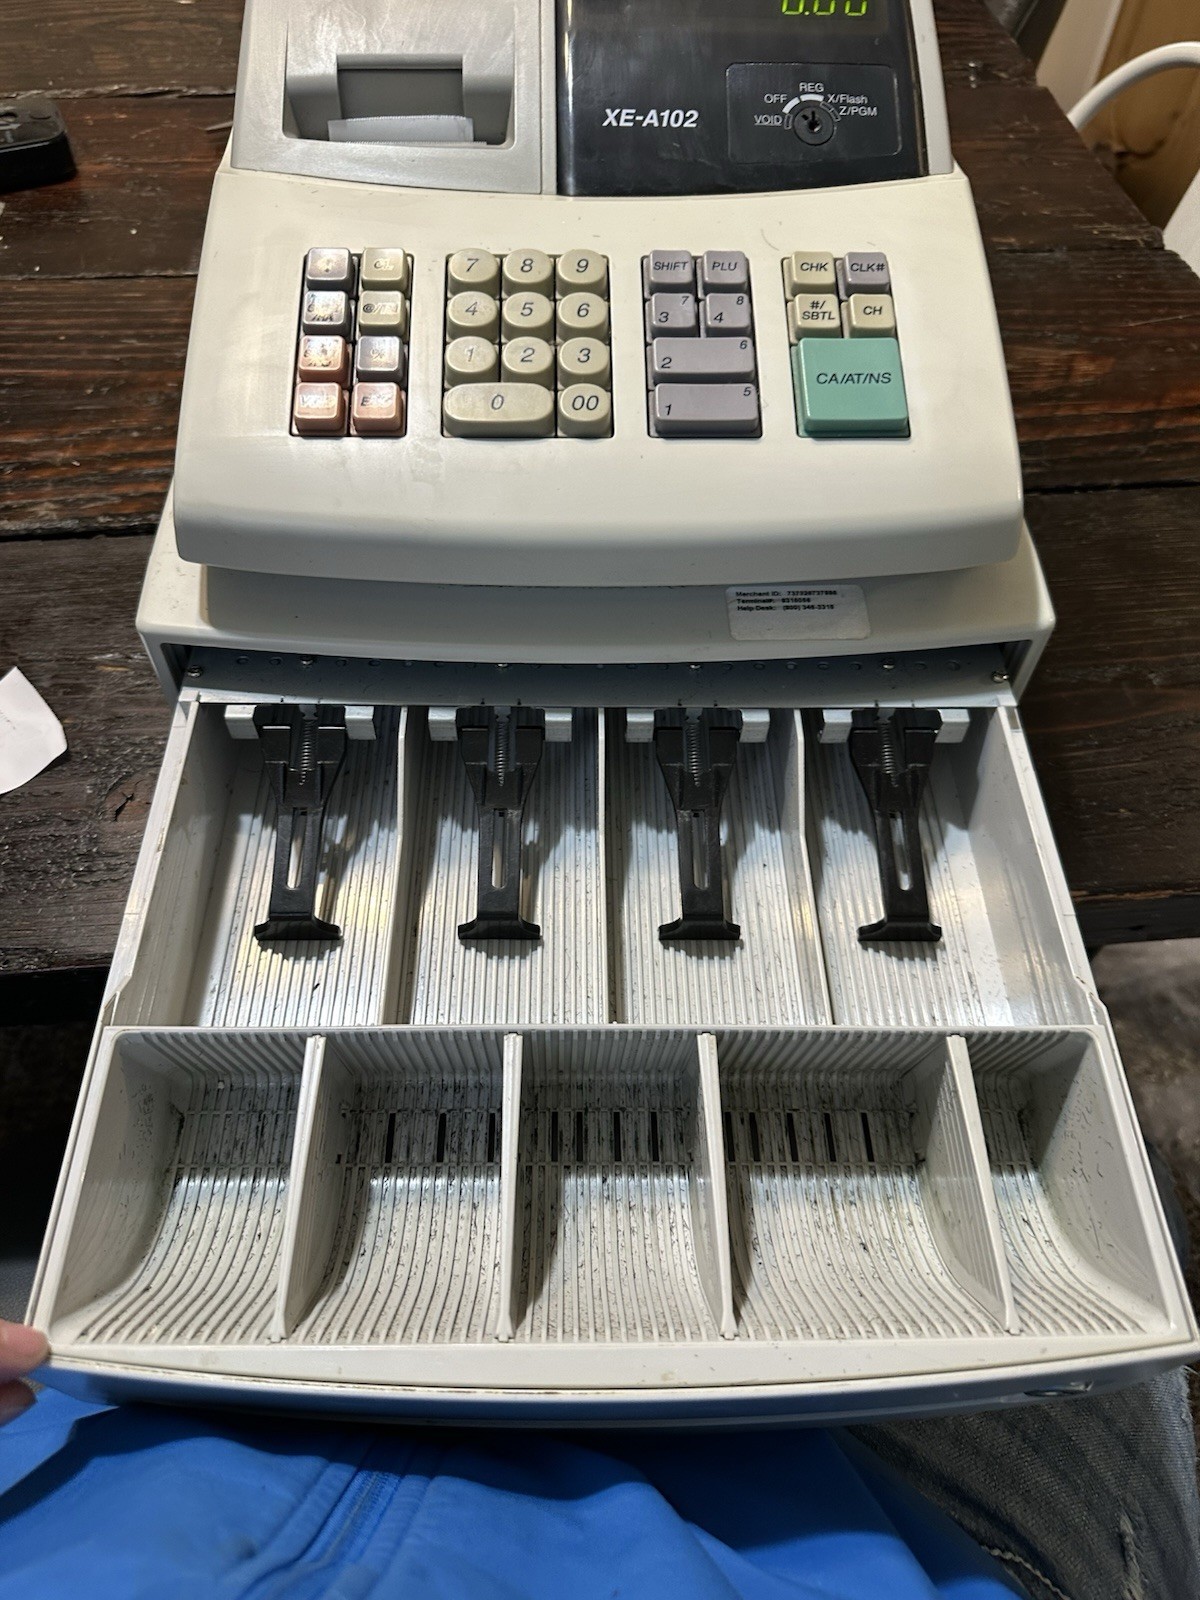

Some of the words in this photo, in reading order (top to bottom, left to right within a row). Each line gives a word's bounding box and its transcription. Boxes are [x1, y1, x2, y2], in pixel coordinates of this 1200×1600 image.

[799, 82, 824, 92] REG
[764, 93, 788, 104] OFF
[827, 93, 868, 105] X/Flash
[839, 105, 878, 117] Z/PGM
[602, 108, 699, 128] XE-A102
[754, 115, 783, 126] VOID
[465, 258, 479, 273] 7
[520, 258, 534, 273] 8
[576, 258, 589, 273] 9
[653, 261, 689, 271] SHIFT
[711, 261, 738, 271] PLU
[799, 262, 829, 271] CHK
[850, 262, 886, 272] CLK#
[681, 295, 689, 305] 7
[736, 295, 745, 305] 8
[809, 300, 826, 310] #/
[465, 301, 478, 316] 4
[520, 302, 534, 317] 5
[577, 303, 590, 318] 6
[862, 305, 883, 315] CH
[658, 311, 669, 323] 3
[713, 312, 724, 323] 4
[801, 311, 836, 320] SBTL
[740, 340, 748, 350] 6
[466, 347, 475, 362] 1
[520, 347, 535, 363] 2
[577, 348, 591, 363] 3
[661, 357, 672, 369] 2
[816, 373, 892, 384] CA/AT/NS
[743, 386, 752, 397] 5
[490, 394, 505, 410] 0
[571, 395, 599, 411] 00
[664, 404, 673, 416] 1
